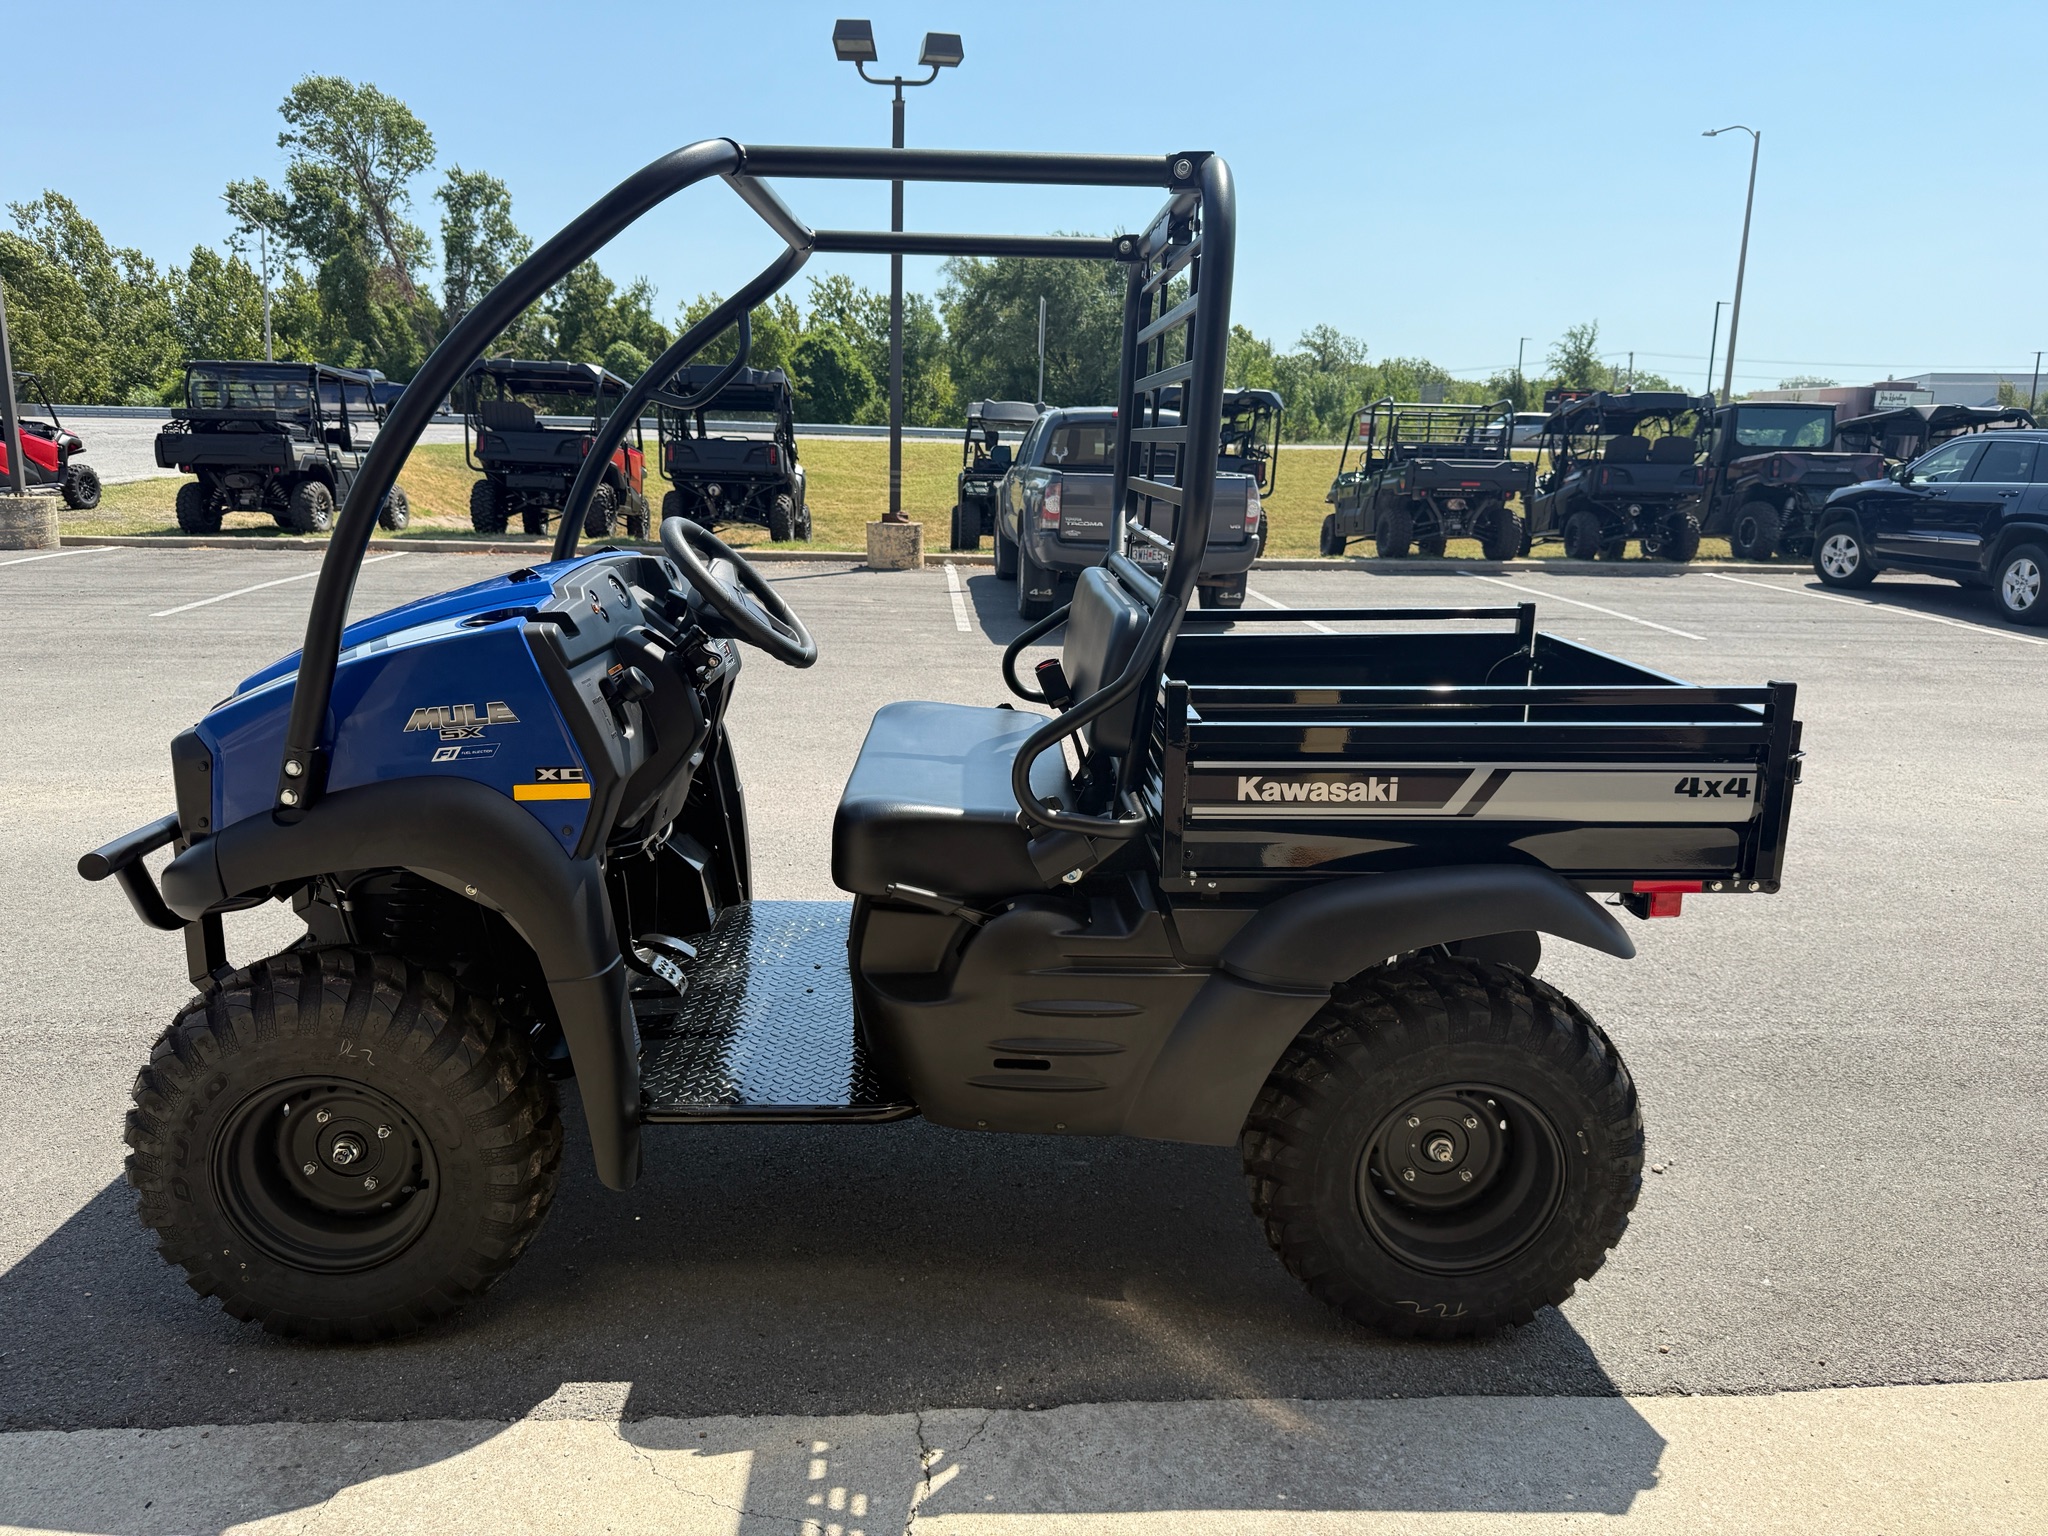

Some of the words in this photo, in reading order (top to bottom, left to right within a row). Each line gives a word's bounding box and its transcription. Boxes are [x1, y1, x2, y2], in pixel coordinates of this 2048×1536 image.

[403, 701, 520, 732] MULE
[439, 726, 485, 741] SX
[536, 768, 583, 781] XC
[1237, 776, 1399, 802] Kawasaki
[1674, 777, 1751, 798] 4x4
